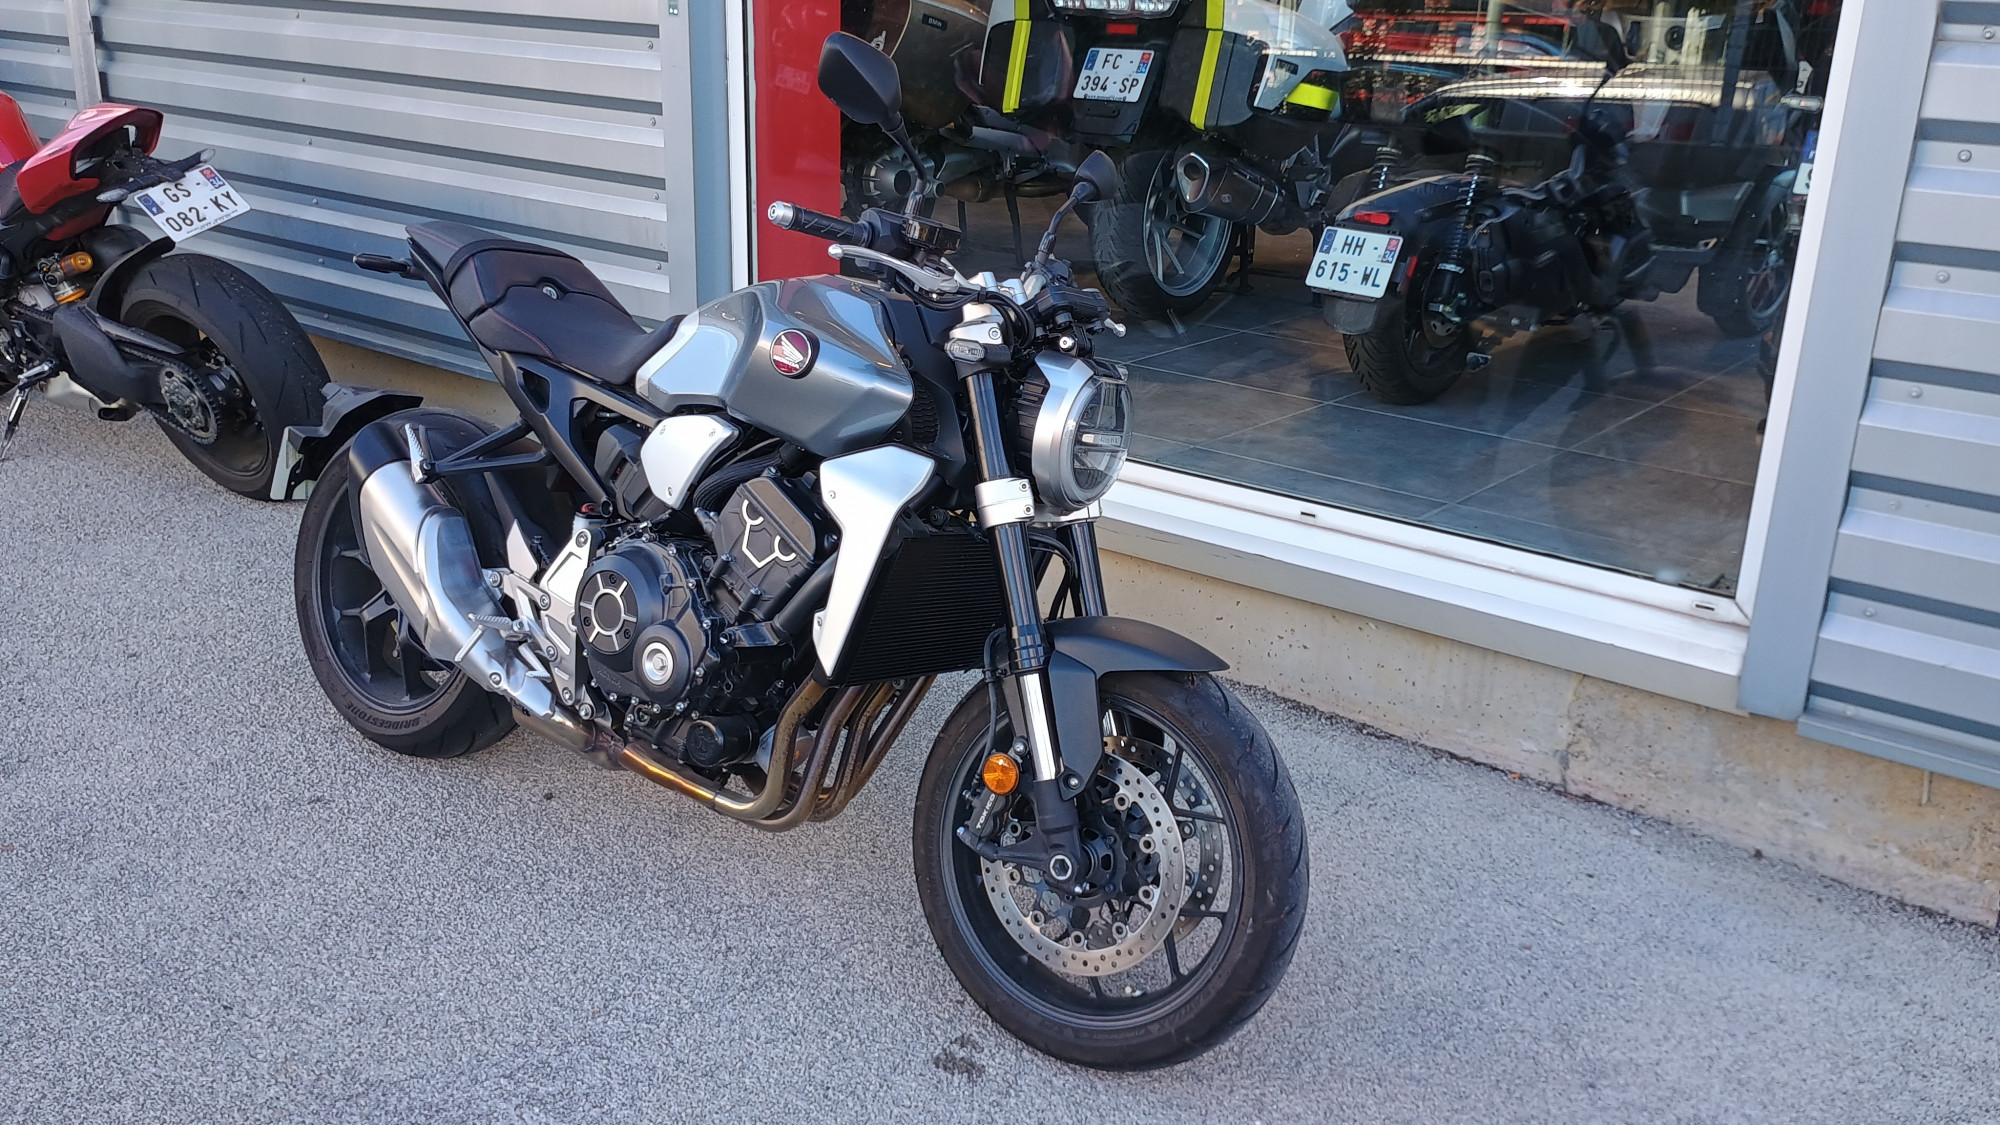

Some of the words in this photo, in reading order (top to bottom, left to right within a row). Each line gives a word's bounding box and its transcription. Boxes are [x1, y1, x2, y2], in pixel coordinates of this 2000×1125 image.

[1101, 53, 1123, 70] FC
[1137, 63, 1148, 73] 34
[209, 177, 224, 188] 34
[162, 182, 192, 203] GS
[1340, 234, 1367, 256] HH
[1383, 250, 1395, 263] 34
[344, 700, 422, 731] BRIDGESTONE
[975, 793, 996, 830] TOKICO
